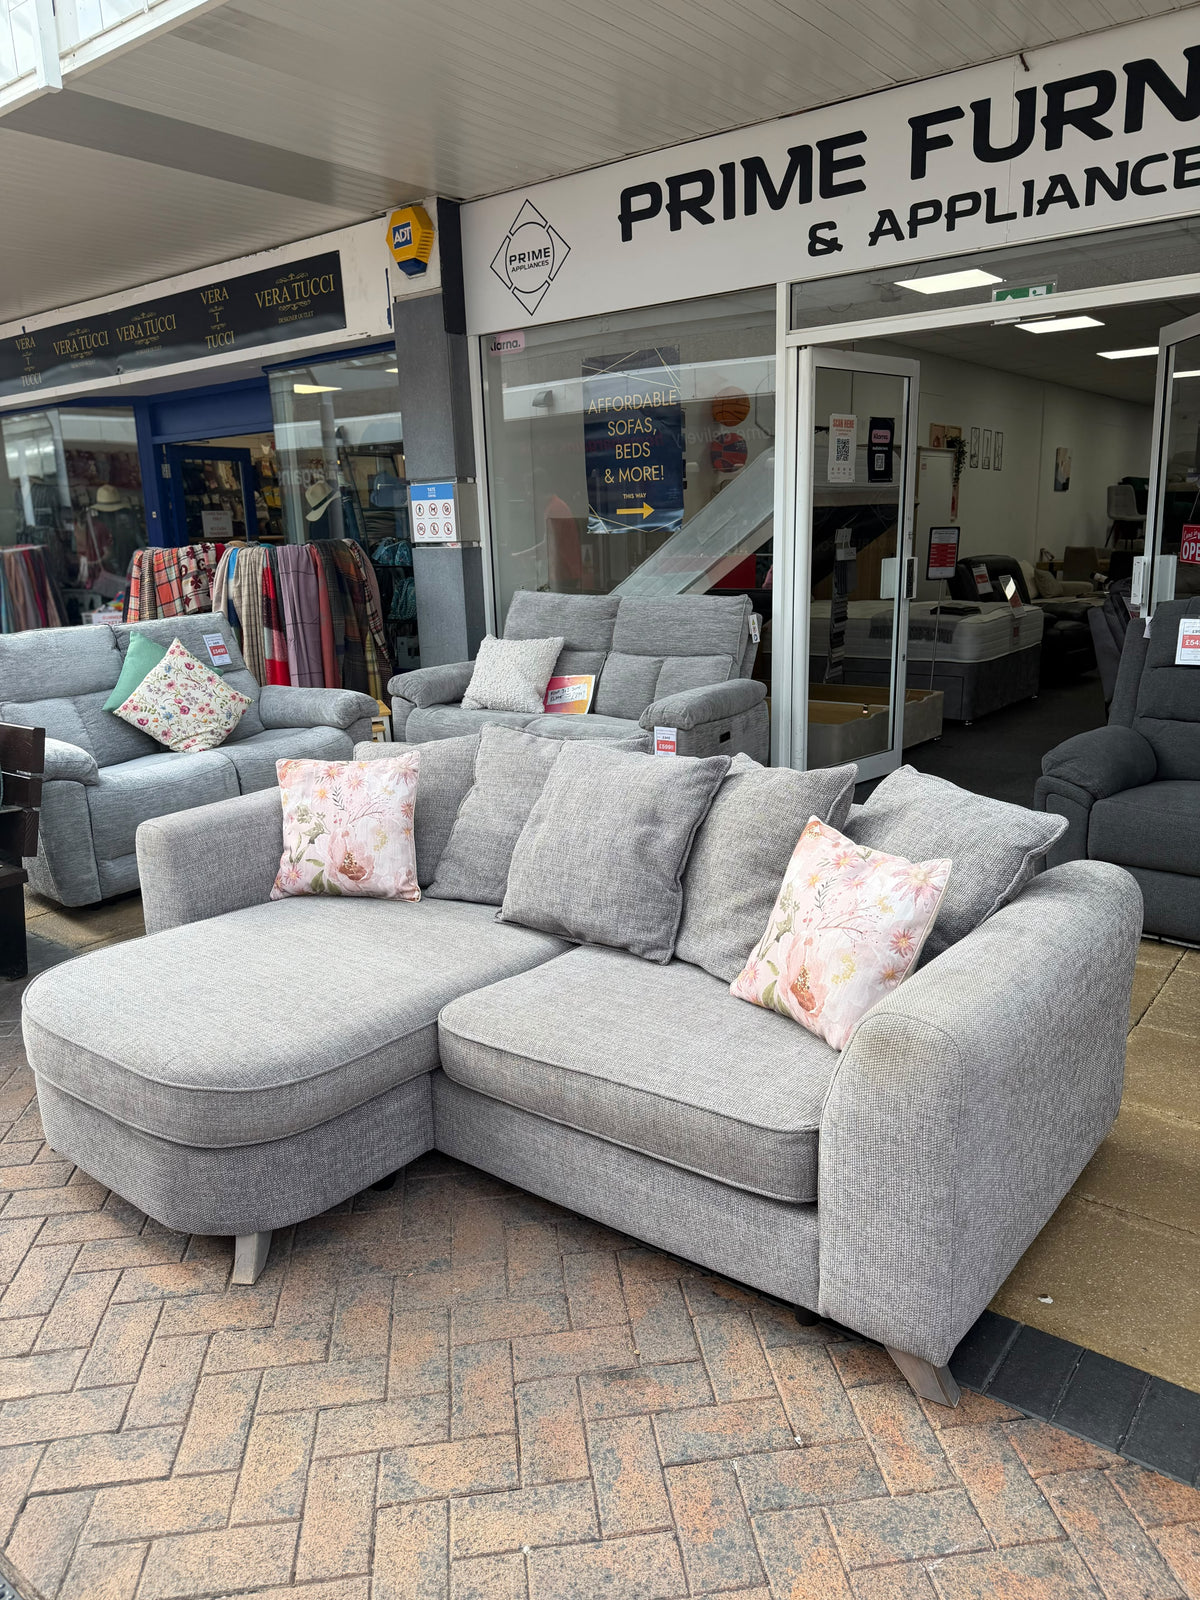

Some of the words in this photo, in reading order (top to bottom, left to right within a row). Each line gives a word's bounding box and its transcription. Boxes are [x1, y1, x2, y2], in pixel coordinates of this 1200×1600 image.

[617, 130, 868, 242] PRIME
[393, 227, 411, 245] ADT
[807, 221, 844, 257] &
[509, 247, 551, 266] PRIME
[511, 260, 550, 273] APPLIANCES
[200, 287, 229, 305] VERA
[255, 286, 291, 309] VERA
[292, 274, 335, 301] TUCCI
[214, 312, 220, 323] T
[116, 323, 144, 342] VERA
[144, 314, 177, 335] TUCCI
[15, 336, 36, 350] VERA
[53, 340, 79, 356] VERA
[79, 331, 109, 350] TUCCI
[205, 330, 235, 350] TUCCI
[21, 372, 42, 387] TUCCI
[588, 389, 678, 415] AFFORDABLE
[608, 417, 657, 436] SOFAS,
[832, 419, 843, 428] SCAN
[844, 419, 855, 428] HERE
[615, 442, 651, 460] BEDS
[604, 468, 615, 484] &
[618, 465, 665, 483] MORE!
